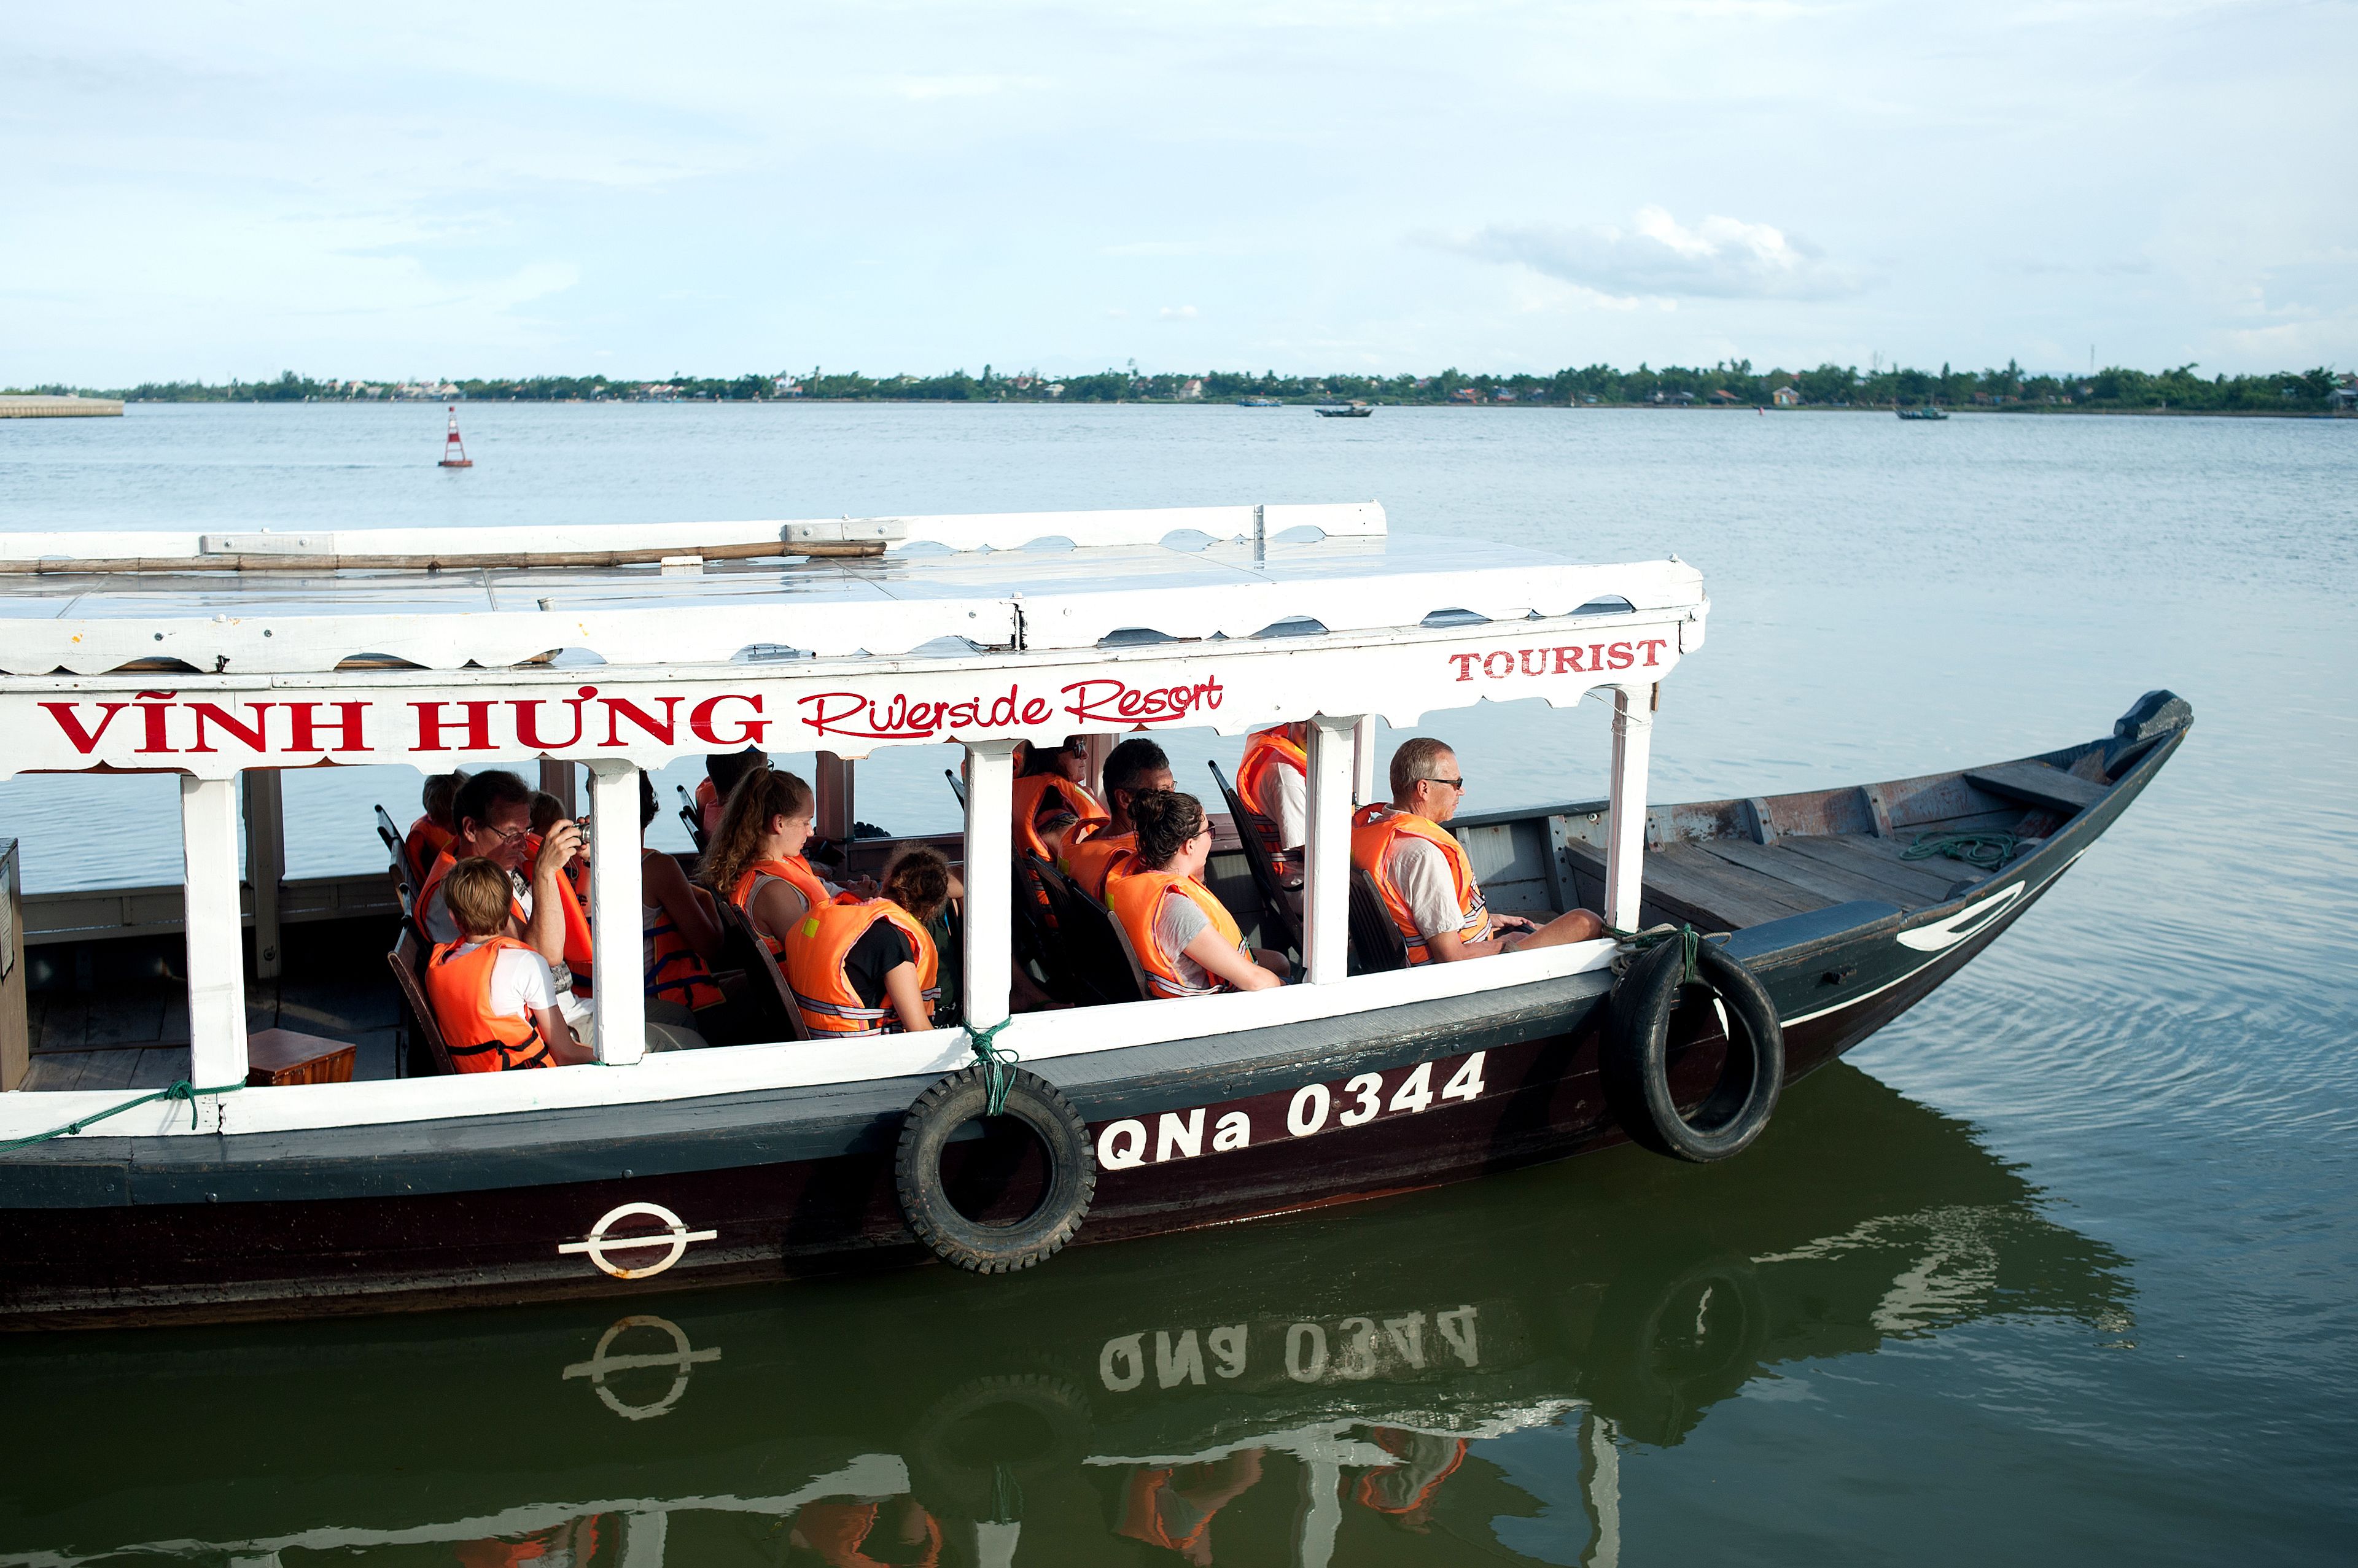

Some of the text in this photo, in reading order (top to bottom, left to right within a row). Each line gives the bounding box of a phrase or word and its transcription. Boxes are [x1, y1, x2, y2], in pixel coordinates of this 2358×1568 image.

[1449, 639, 1667, 681] TOURIST
[37, 674, 1224, 755] VĨNH HƯNG Riverside Resort
[1097, 1050, 1486, 1170] QNa 0344
